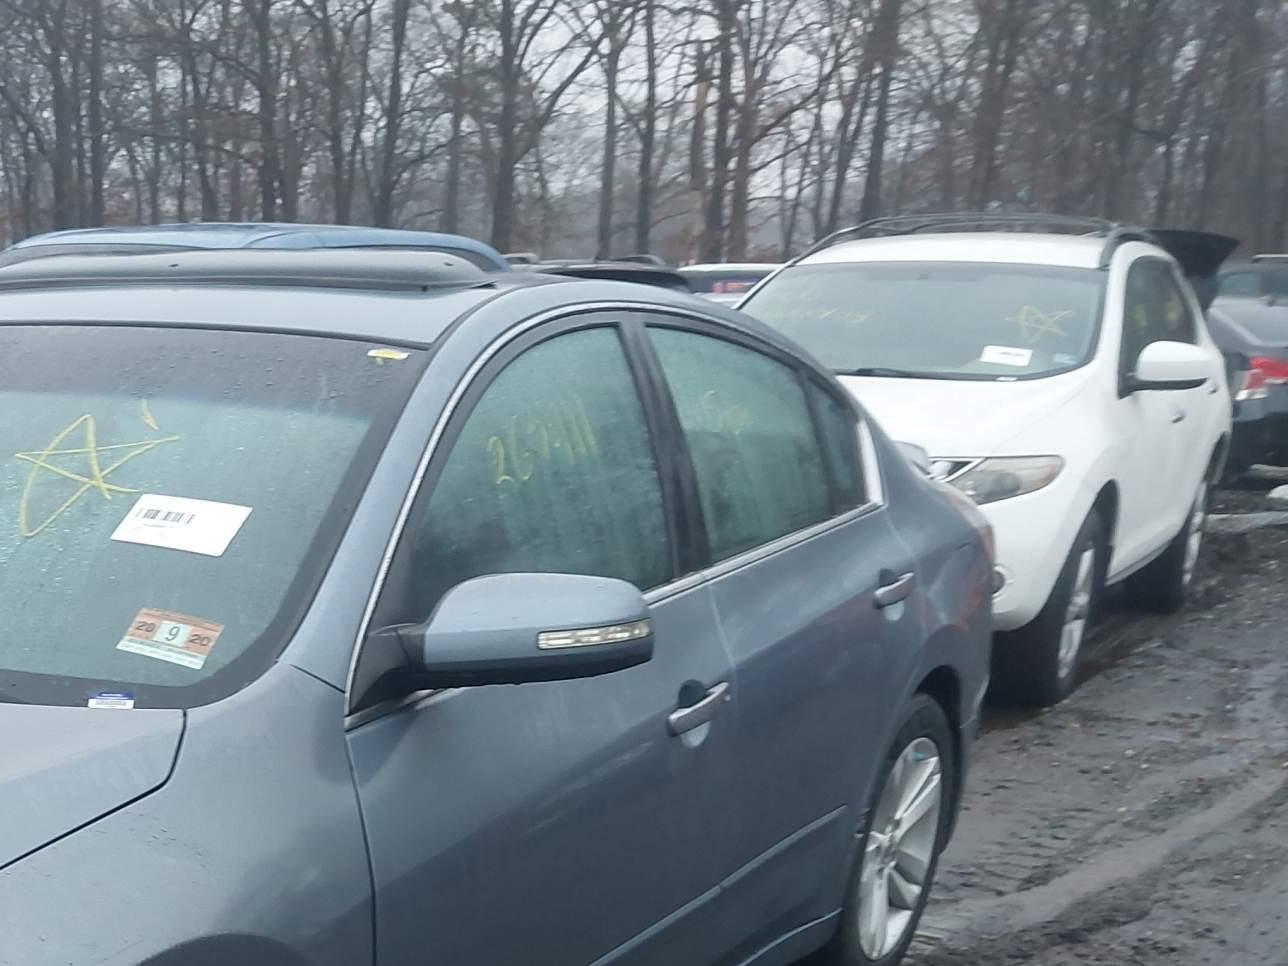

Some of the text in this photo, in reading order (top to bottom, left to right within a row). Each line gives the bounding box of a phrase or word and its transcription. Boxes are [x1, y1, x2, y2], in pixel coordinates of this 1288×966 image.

[135, 620, 157, 633] 20
[164, 625, 181, 642] 9
[189, 633, 212, 647] 20
